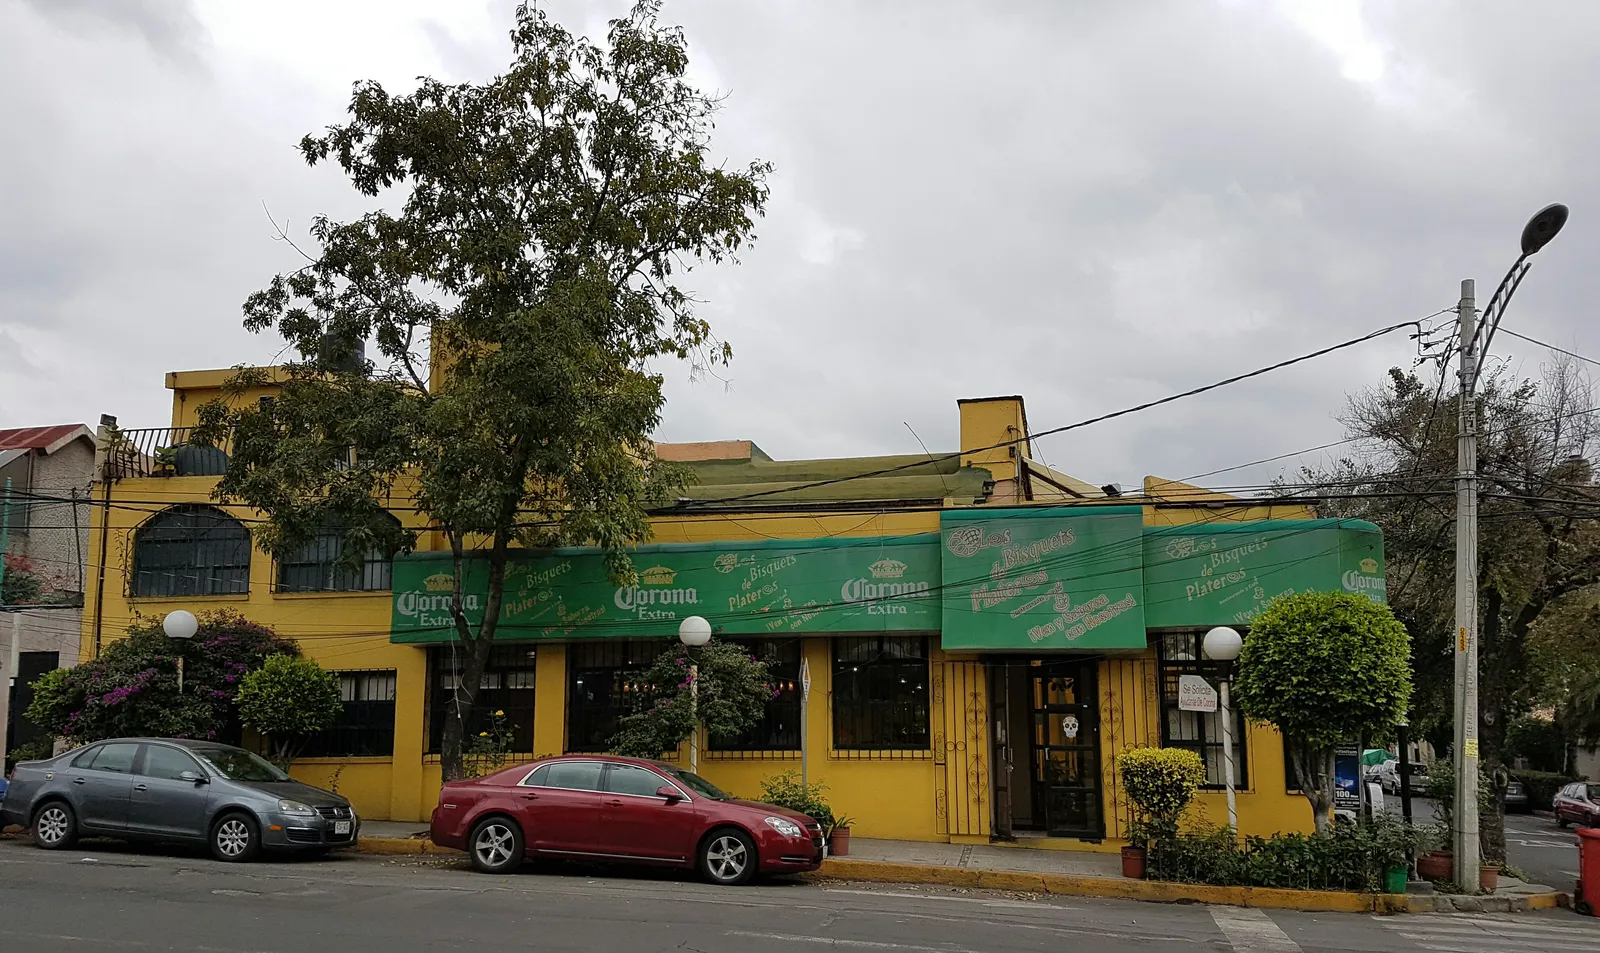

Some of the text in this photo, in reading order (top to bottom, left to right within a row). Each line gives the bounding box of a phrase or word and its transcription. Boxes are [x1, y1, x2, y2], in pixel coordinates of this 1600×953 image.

[1001, 527, 1076, 569] Bisquets
[1210, 537, 1269, 568] Bisquets
[525, 560, 573, 588] Bisquets
[749, 555, 797, 582] Bisquets
[990, 561, 1008, 581] de
[1201, 564, 1213, 577] de
[728, 580, 779, 613] Plateros
[741, 578, 752, 590] de
[841, 577, 932, 606] Corona
[1185, 567, 1247, 602] Plateros
[397, 590, 480, 618] Coroa
[614, 587, 699, 612] Corona
[867, 604, 908, 615] Extra
[420, 613, 457, 626] Extra
[638, 607, 676, 620] Extra
[1183, 684, 1191, 695] Se
[1335, 790, 1350, 798] 100
